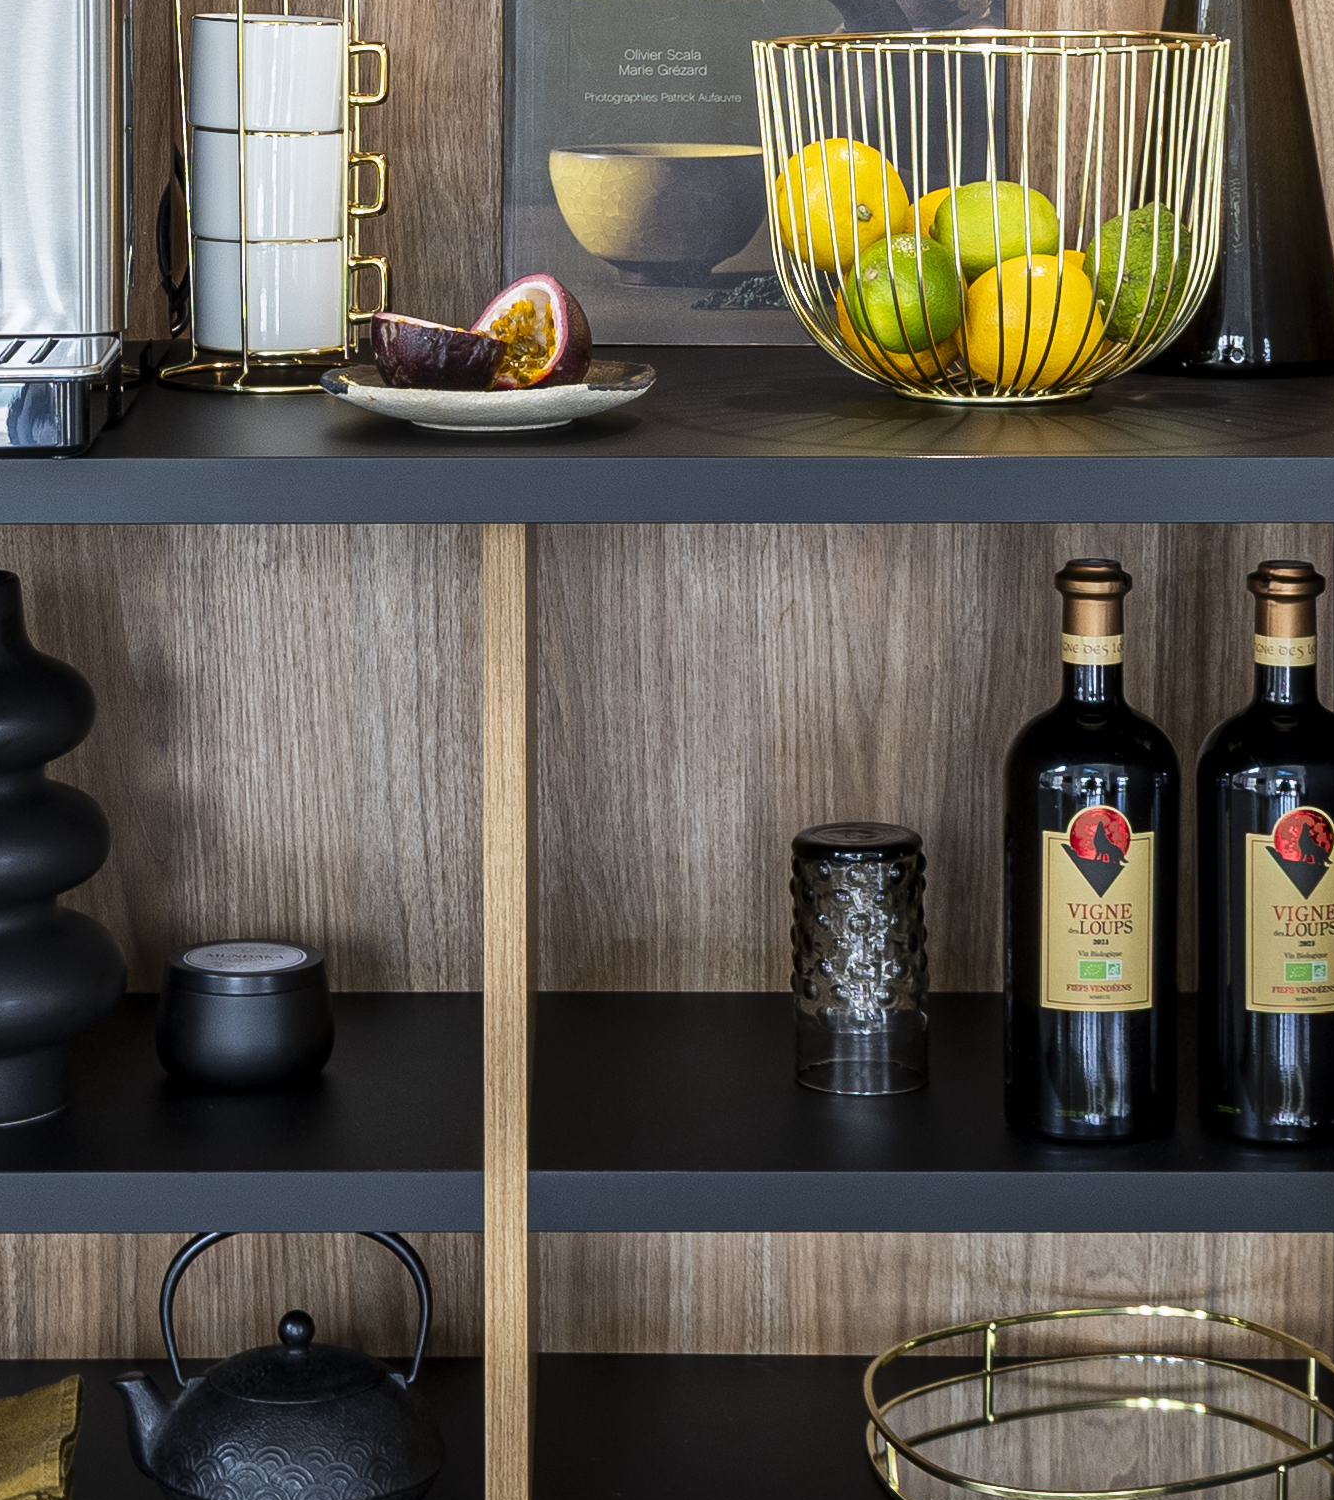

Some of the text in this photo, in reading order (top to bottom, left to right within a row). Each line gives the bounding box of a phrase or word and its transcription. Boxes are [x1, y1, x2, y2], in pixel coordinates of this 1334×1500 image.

[624, 49, 702, 61] Olivier Scala
[618, 64, 708, 76] Marie Grézard
[584, 92, 658, 105] Photographies
[661, 92, 695, 103] Patrick
[1067, 903, 1133, 920] VIGNE
[1079, 919, 1134, 935] LOUPS
[1078, 949, 1090, 957] Vin
